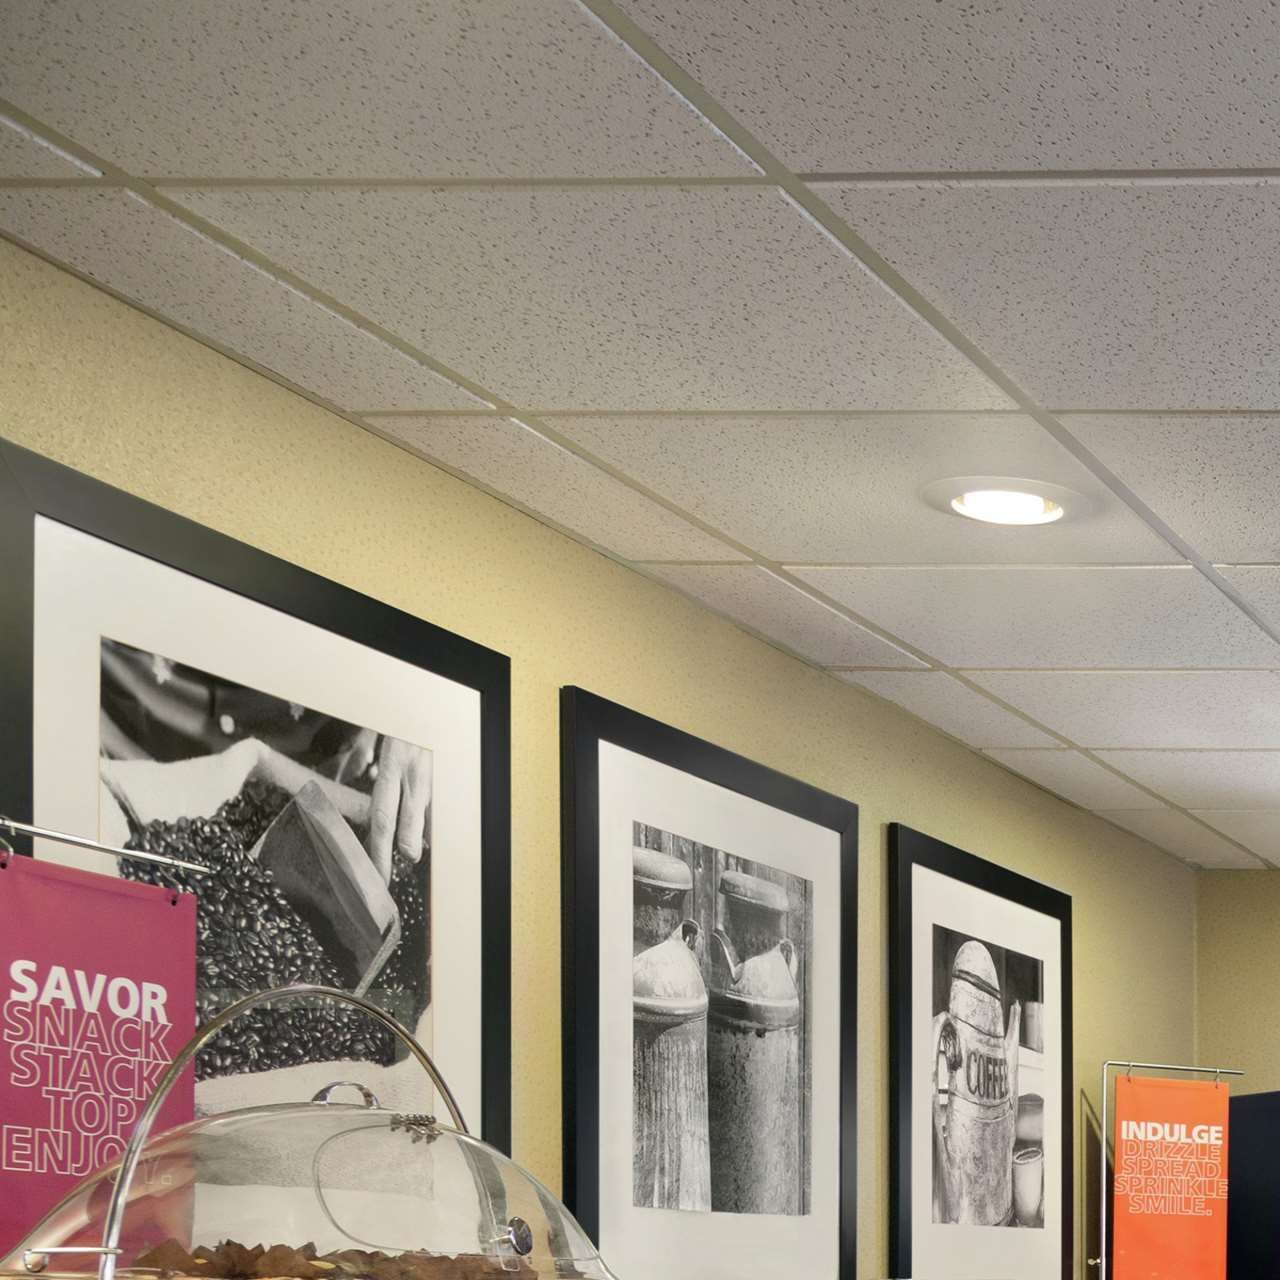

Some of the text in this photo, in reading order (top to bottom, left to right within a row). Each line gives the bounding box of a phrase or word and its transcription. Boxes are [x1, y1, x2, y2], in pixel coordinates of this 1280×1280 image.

[9, 959, 168, 1025] SAVOR
[3, 999, 173, 1064] SNACK
[10, 1042, 166, 1101] STACK
[42, 1087, 137, 1137] TOP
[1121, 1120, 1223, 1145] INDULGE
[1122, 1139, 1221, 1161] DRIZZLE
[1122, 1156, 1221, 1180] SPREAD
[1114, 1174, 1229, 1200] SPRINKLE
[1128, 1194, 1213, 1217] SMILE.
